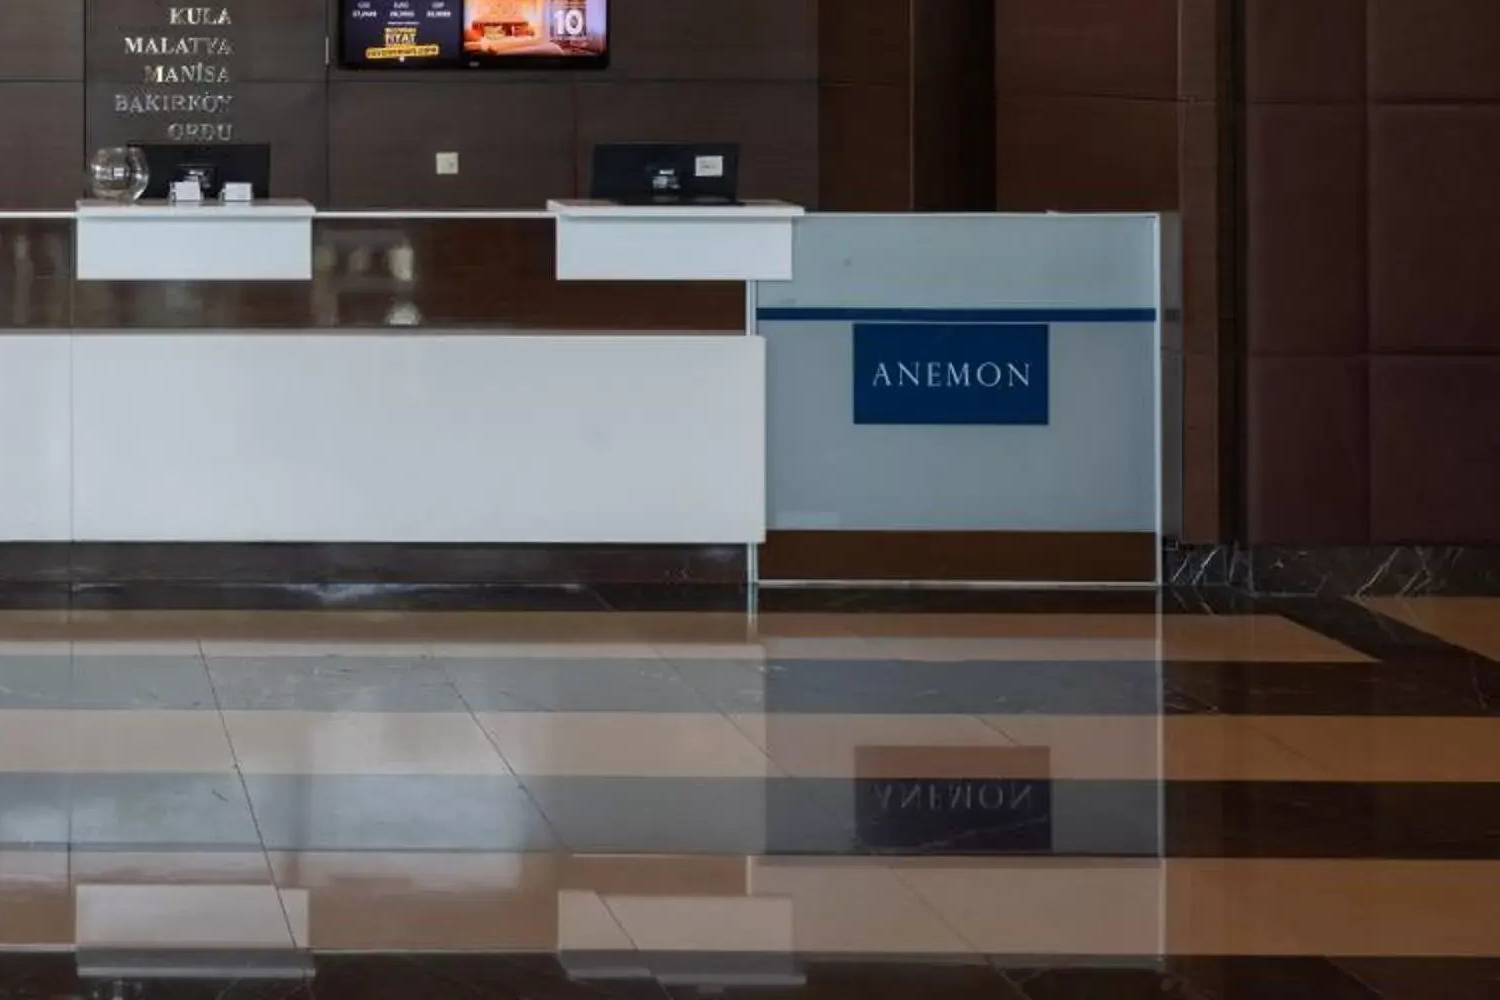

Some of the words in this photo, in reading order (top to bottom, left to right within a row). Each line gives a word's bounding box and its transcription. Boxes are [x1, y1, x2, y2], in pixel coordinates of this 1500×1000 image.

[169, 7, 231, 25] KULA
[553, 9, 583, 35] 10
[124, 36, 234, 55] MALATYA
[167, 122, 233, 141] ORDU
[872, 361, 1033, 388] ANEMON
